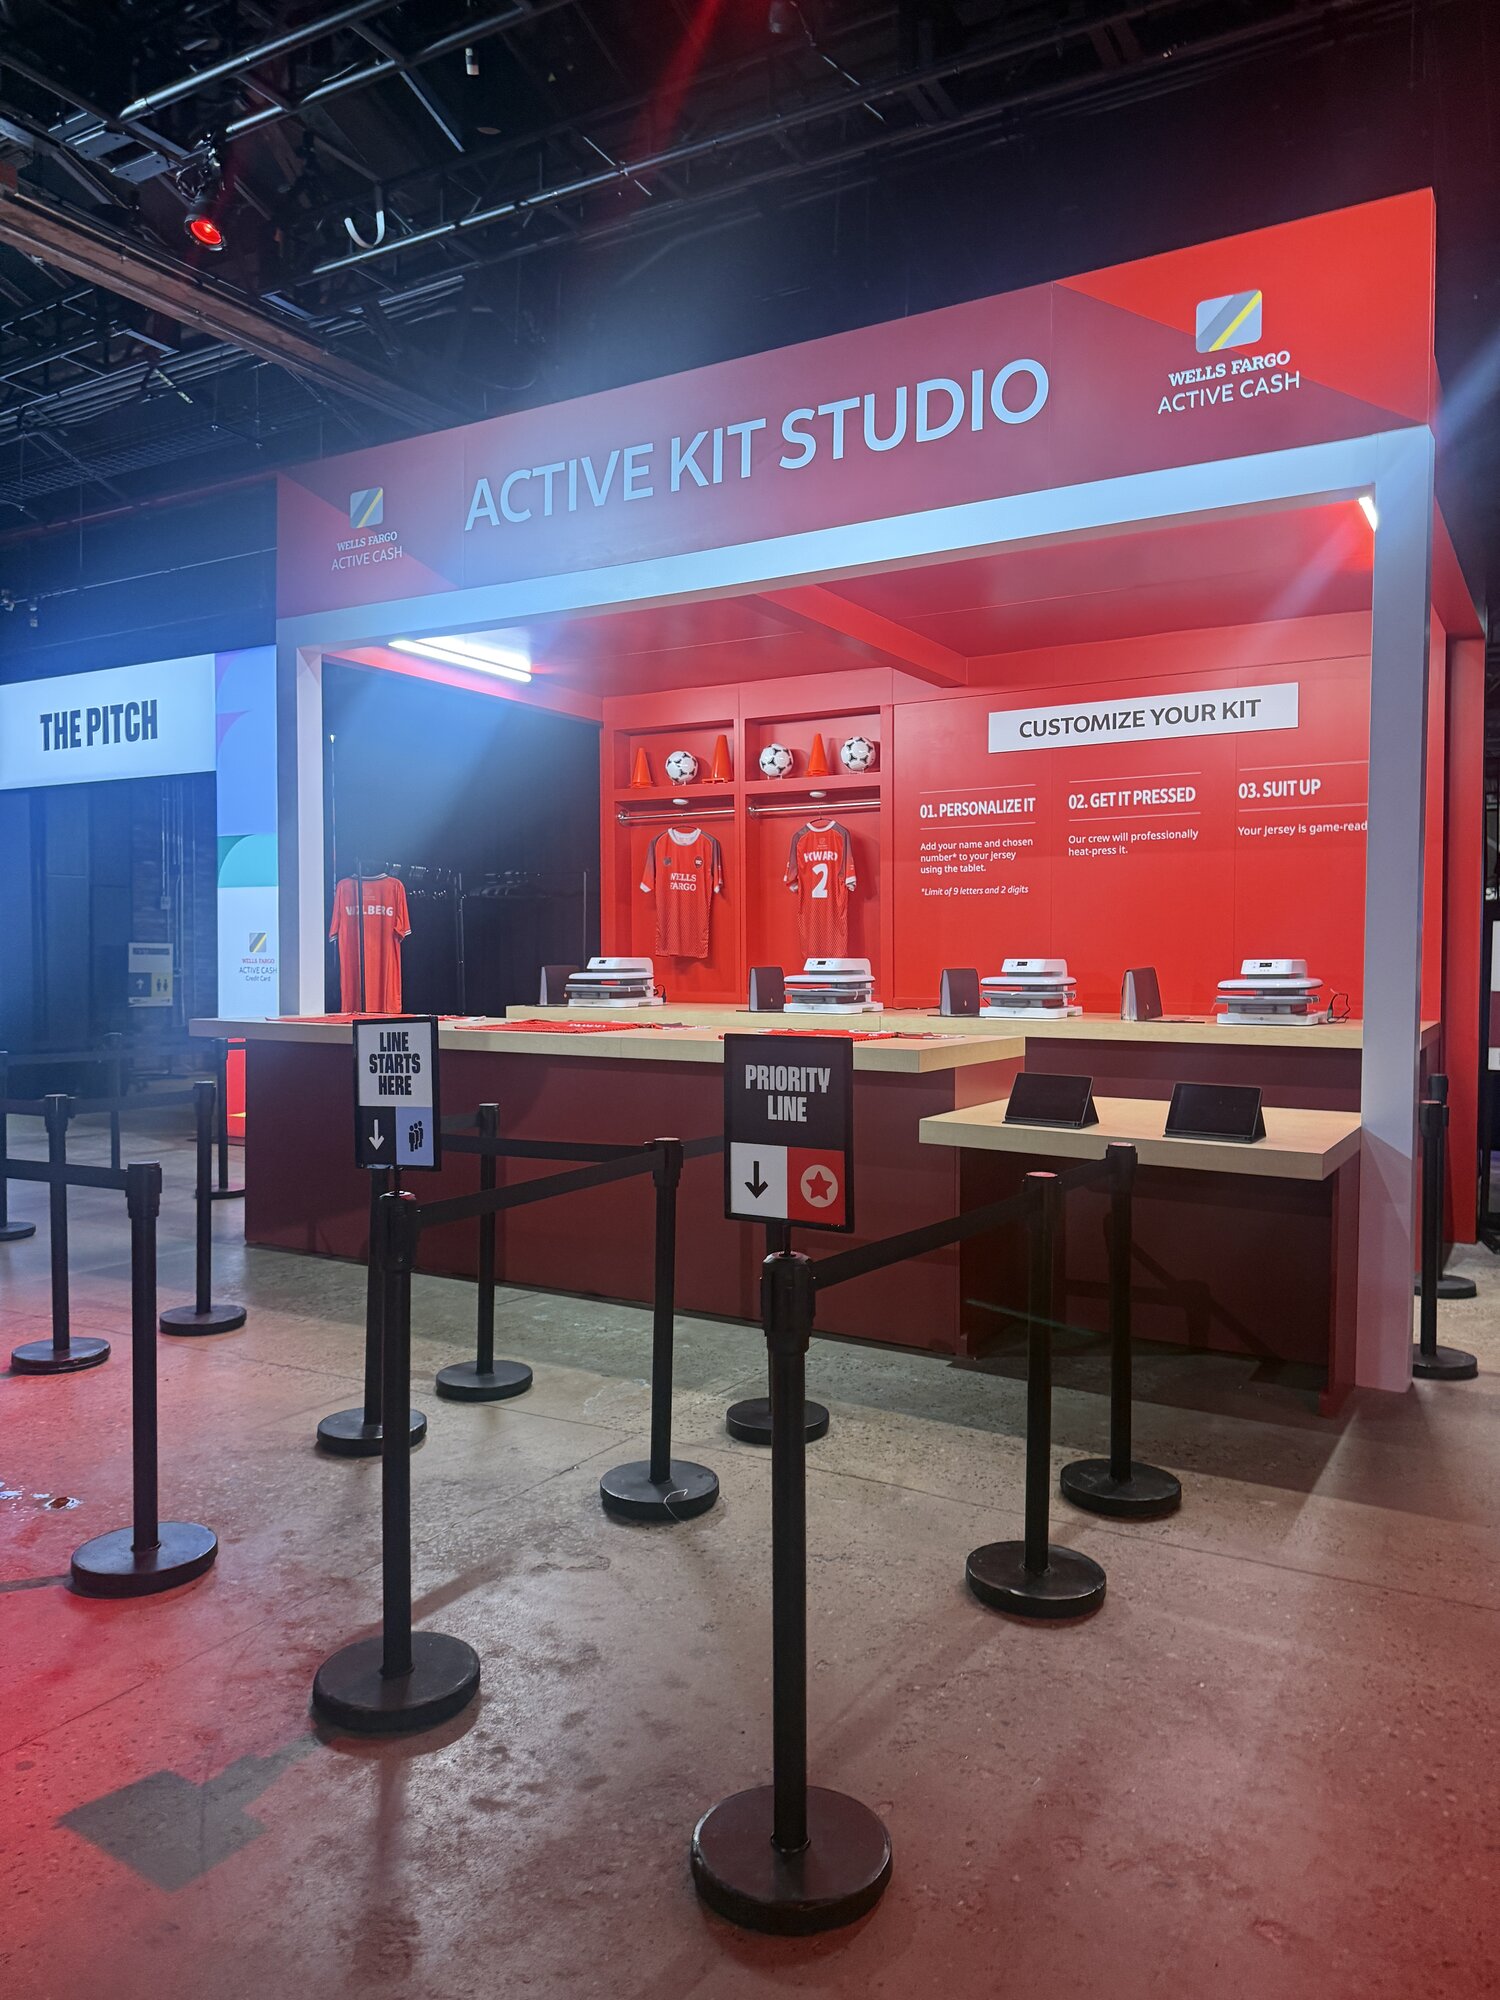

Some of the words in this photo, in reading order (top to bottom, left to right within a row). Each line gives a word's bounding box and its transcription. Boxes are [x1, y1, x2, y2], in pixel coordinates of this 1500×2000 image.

[1168, 368, 1226, 387] WELLS
[1231, 351, 1291, 373] FARGO
[1157, 384, 1234, 414] ACTIVE
[1240, 371, 1301, 400] CASH
[465, 443, 654, 531] ACTIVE
[671, 418, 766, 492] KIT
[779, 358, 1048, 469] STUDIO
[336, 538, 366, 552] WELLS
[368, 531, 398, 546] FARGO
[331, 552, 370, 571] ACTIVE
[372, 546, 402, 563] CASH
[40, 708, 81, 751] THE
[87, 700, 158, 746] PITCH
[1019, 710, 1146, 739] CUSTOMIZE
[1150, 703, 1217, 726] YOUR
[1221, 698, 1262, 720] KIT
[1068, 794, 1089, 809] 02.
[1090, 792, 1117, 808] GET
[1118, 790, 1131, 807] IT
[1133, 786, 1196, 805] PRESSED
[1238, 782, 1261, 799] 03.
[1262, 780, 1297, 798] SUIT
[1299, 778, 1321, 795] UP
[919, 804, 938, 819] 01.
[939, 798, 1023, 818] PERSONALIZE
[1023, 797, 1036, 812] IT
[1068, 835, 1086, 844] Our
[1088, 833, 1110, 843] crew
[1112, 832, 1129, 842] will
[1130, 829, 1199, 843] professionally
[1238, 826, 1262, 836] Your
[1263, 825, 1296, 837] jersey
[1298, 824, 1307, 833] is
[1309, 820, 1368, 836] game-read
[920, 842, 937, 851] Add
[938, 842, 957, 852] your
[958, 841, 982, 849] name
[984, 839, 1001, 848] and
[1002, 838, 1033, 847] chosen
[1068, 846, 1117, 858] heat-press
[1118, 845, 1129, 854] it.
[959, 852, 967, 861] to
[969, 852, 989, 863] your
[990, 850, 1016, 862] jersey
[811, 862, 829, 899] 2
[920, 865, 943, 876] using
[944, 864, 958, 873] the
[959, 864, 986, 873] tablet.
[944, 887, 952, 897] of
[953, 886, 959, 896] 9
[960, 886, 983, 895] letters
[984, 886, 999, 894] and
[1001, 885, 1006, 894] 2
[1007, 885, 1029, 896] digits
[239, 966, 260, 975] ACTIVE
[261, 966, 278, 975] CASH
[379, 1031, 410, 1053] LINE
[369, 1052, 422, 1075] STARTS
[378, 1074, 412, 1097] HERE
[745, 1063, 832, 1093] PRIORITY
[766, 1095, 808, 1123] LINE
